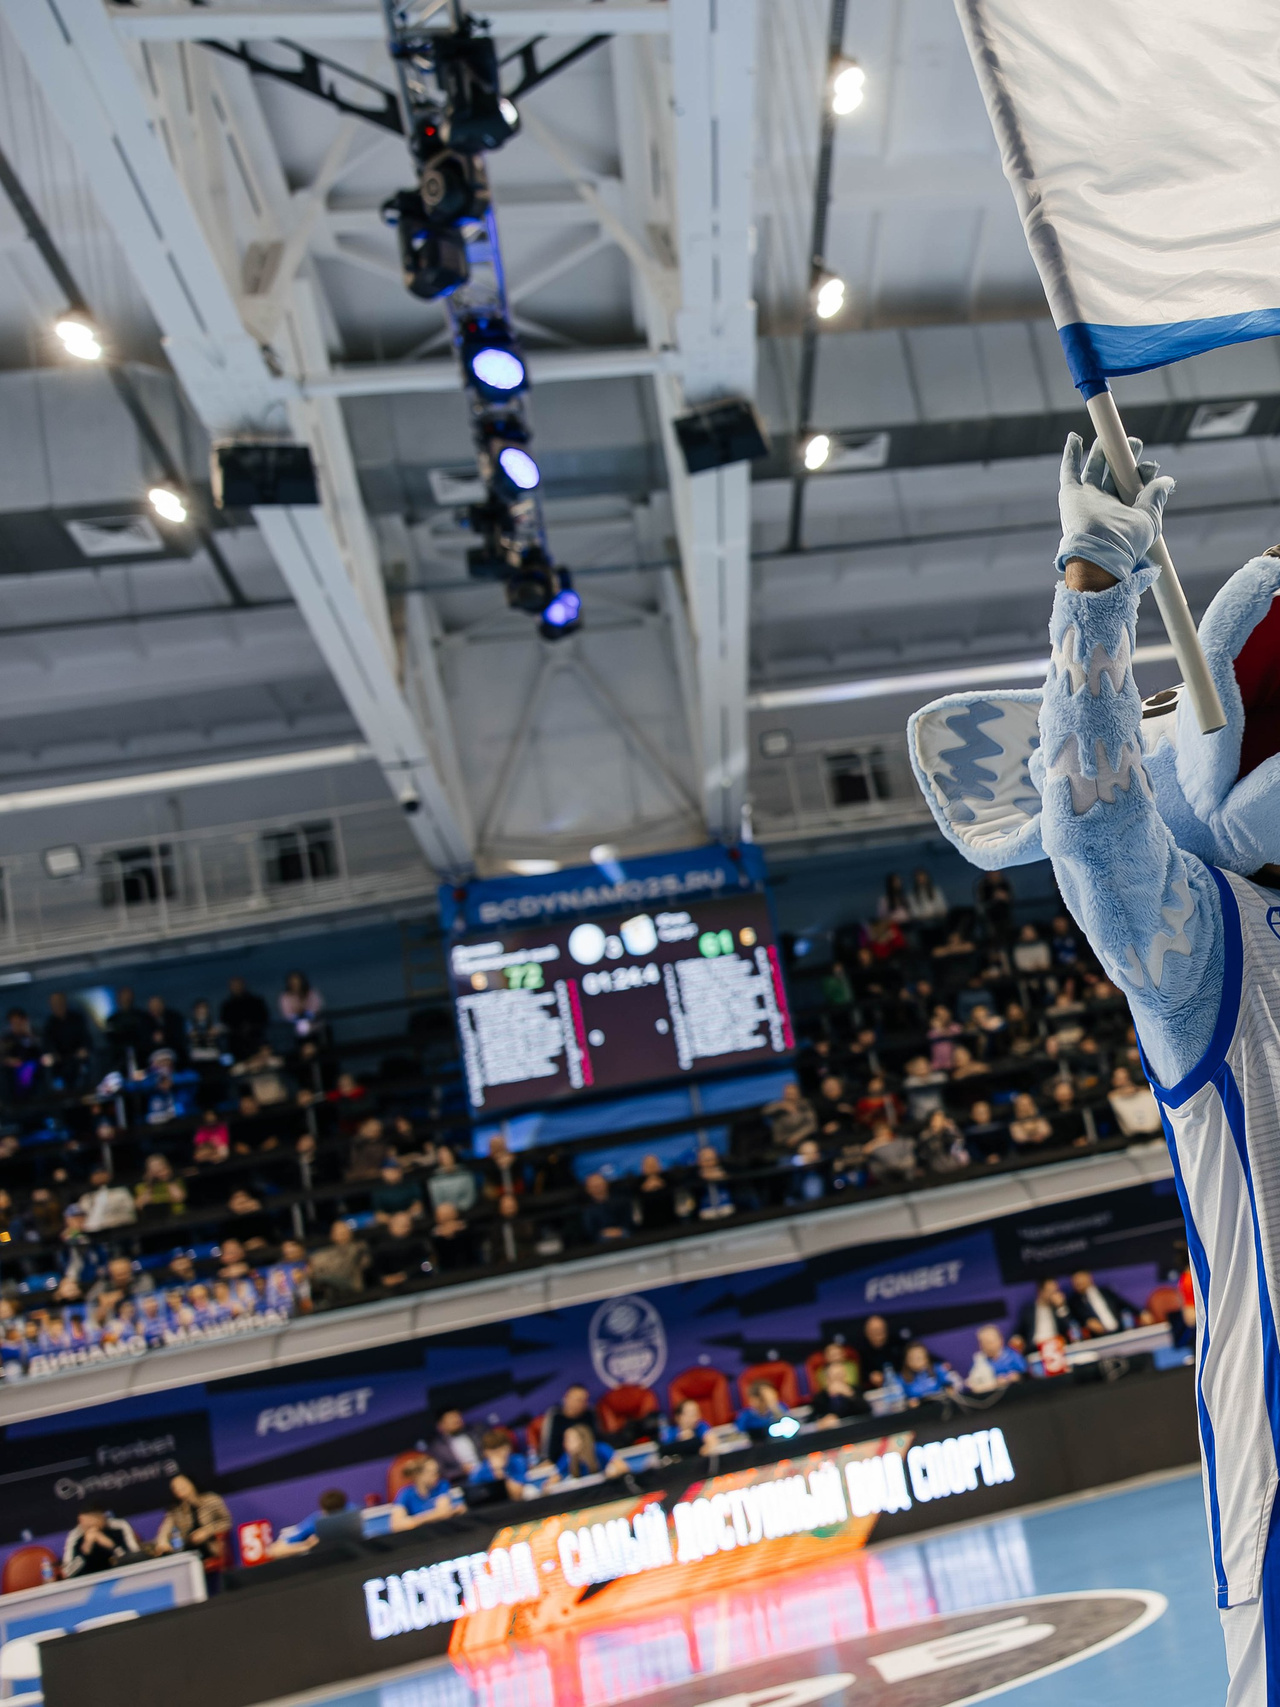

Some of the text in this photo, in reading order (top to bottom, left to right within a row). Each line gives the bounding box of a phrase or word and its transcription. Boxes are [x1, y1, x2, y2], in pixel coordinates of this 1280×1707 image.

[865, 1259, 964, 1303] FONBET
[256, 1386, 373, 1437] FONBET
[362, 1541, 540, 1641] БАСКЕТБОЛ
[557, 1501, 674, 1588] САМЫЙ
[671, 1461, 849, 1564] ДОСТУПНЫЙ
[844, 1451, 913, 1518] ВИД
[906, 1427, 1016, 1503] СПОРТА
